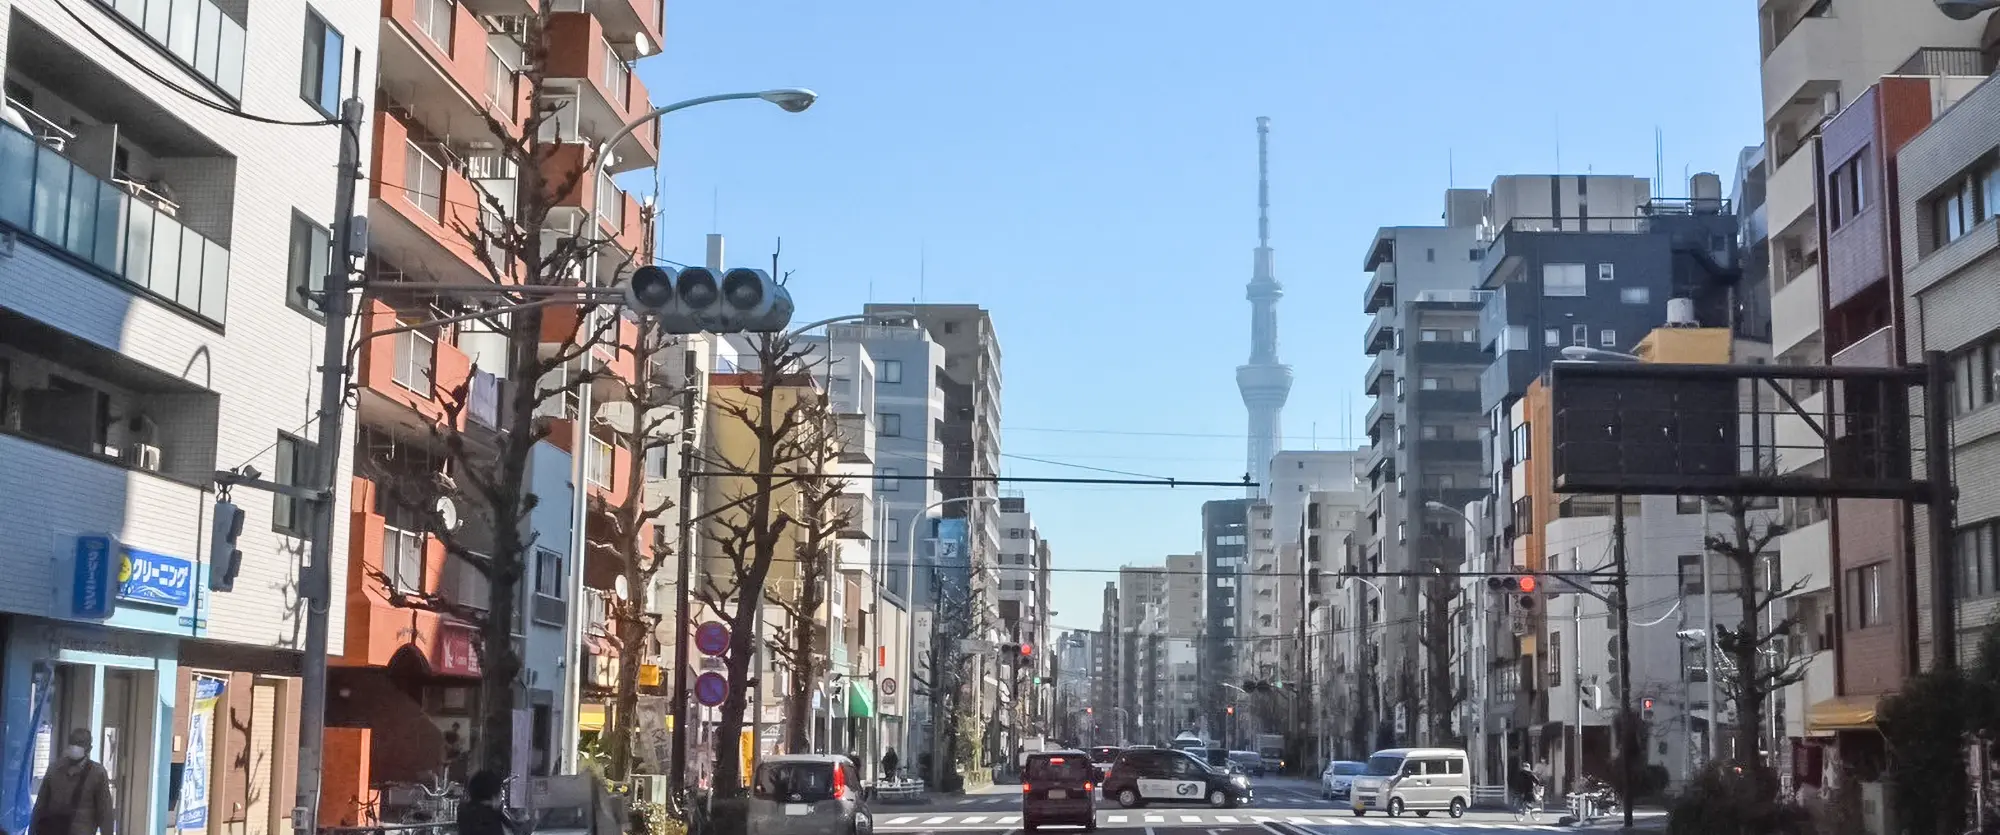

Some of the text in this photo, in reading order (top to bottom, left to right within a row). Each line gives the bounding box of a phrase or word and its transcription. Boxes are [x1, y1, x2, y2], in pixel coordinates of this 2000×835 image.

[132, 558, 189, 589] クリーニング
